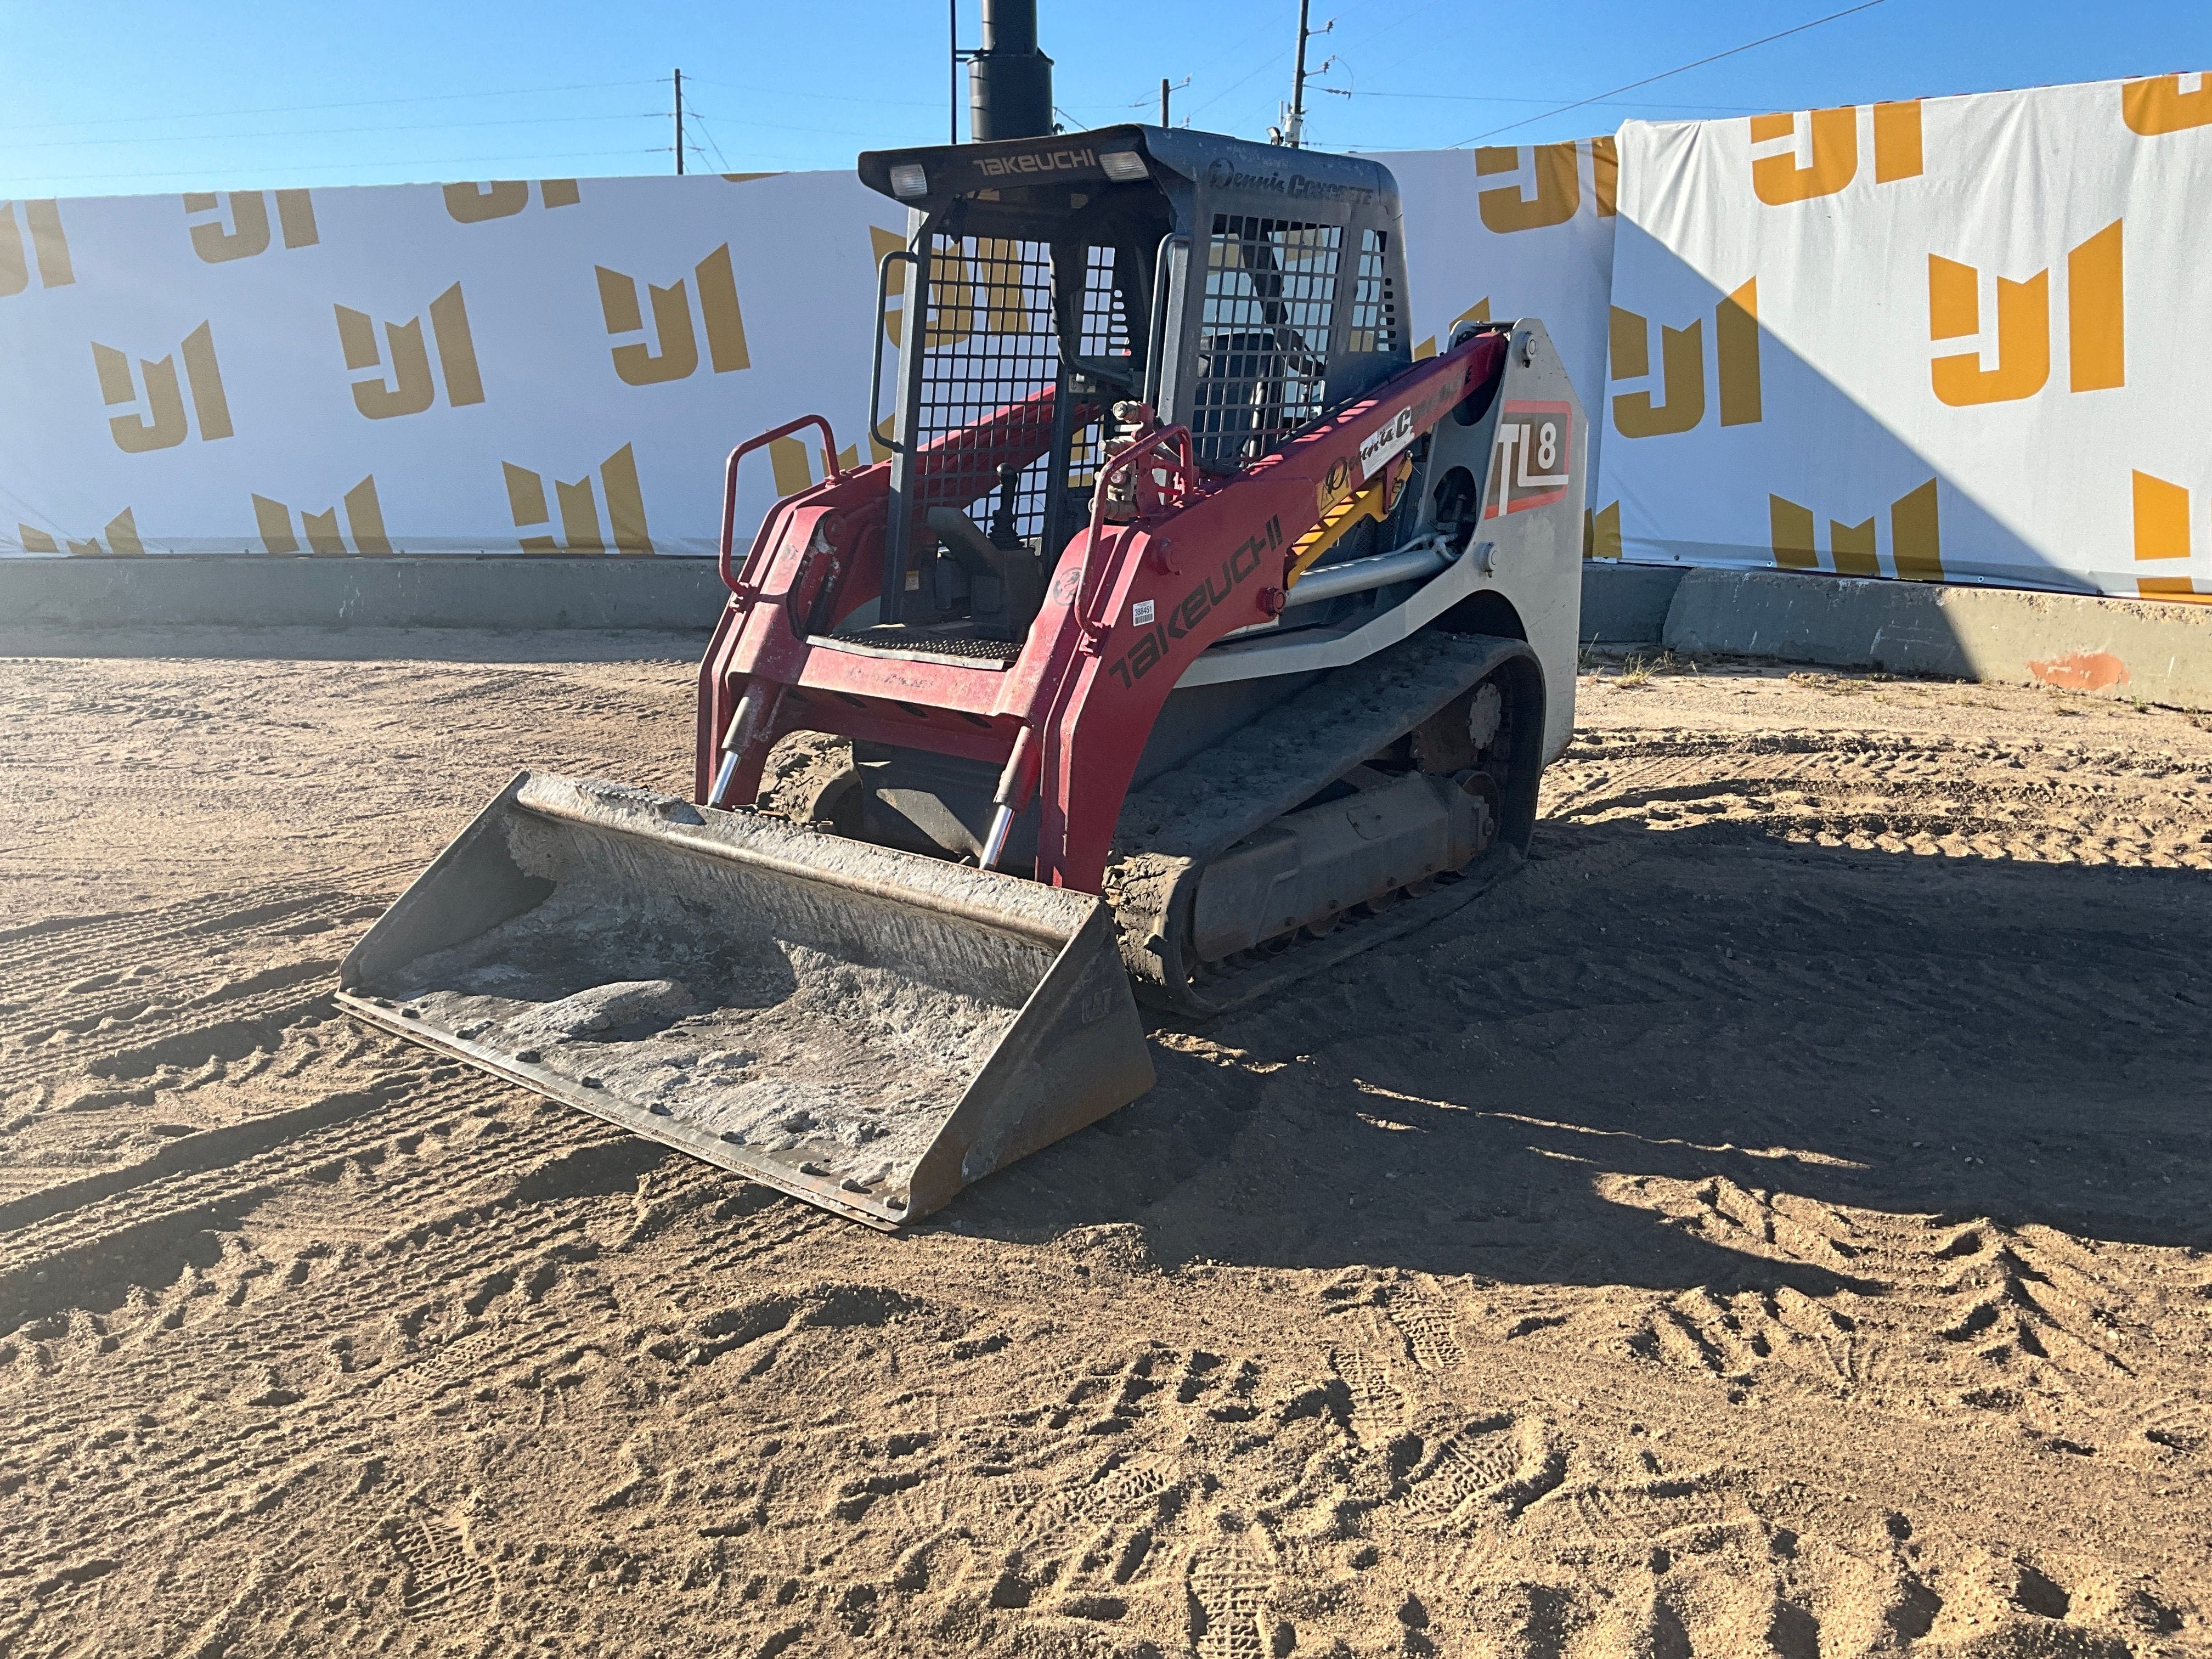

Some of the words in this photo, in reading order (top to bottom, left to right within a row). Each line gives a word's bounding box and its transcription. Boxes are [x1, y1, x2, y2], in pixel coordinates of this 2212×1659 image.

[972, 149, 1096, 176] TAKEUCHI
[1498, 422, 1569, 517] TL8
[1108, 514, 1283, 690] TAKEUCHI
